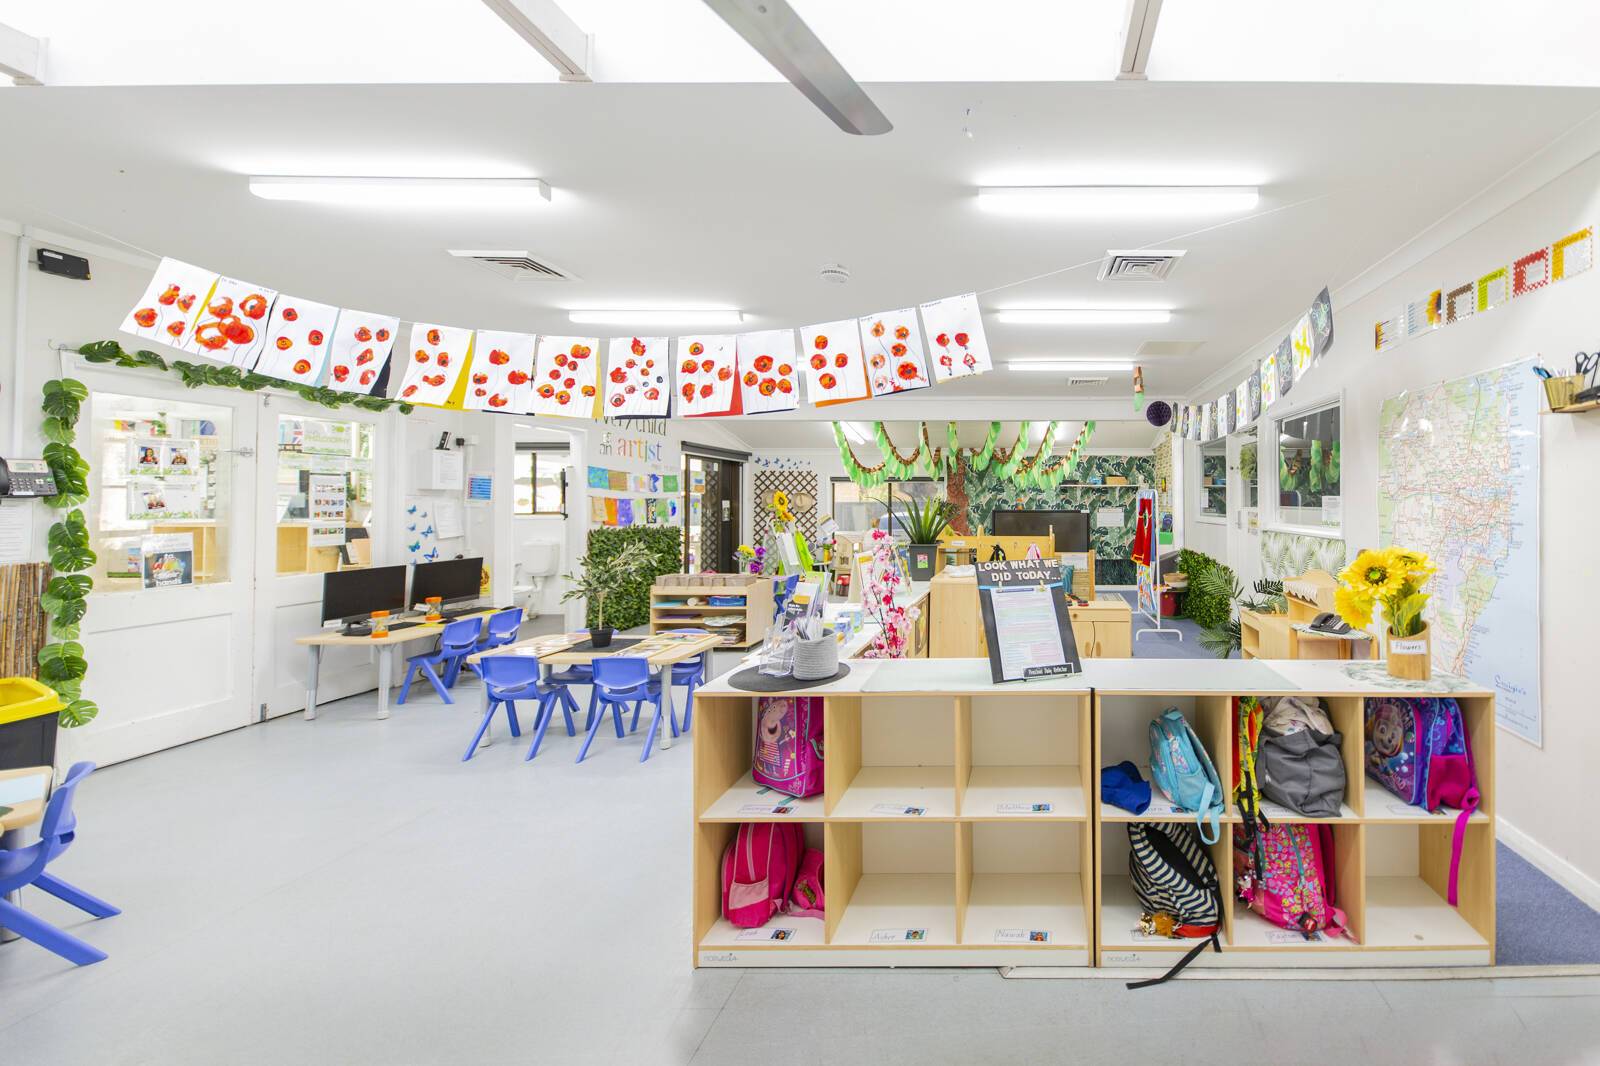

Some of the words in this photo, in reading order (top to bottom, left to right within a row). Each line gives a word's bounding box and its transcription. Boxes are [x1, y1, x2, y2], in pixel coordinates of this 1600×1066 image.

[617, 438, 663, 463] artist
[977, 562, 1008, 572] LOOK
[1010, 560, 1041, 570] WHAT
[1043, 559, 1059, 568] WE
[991, 572, 1012, 582] DID
